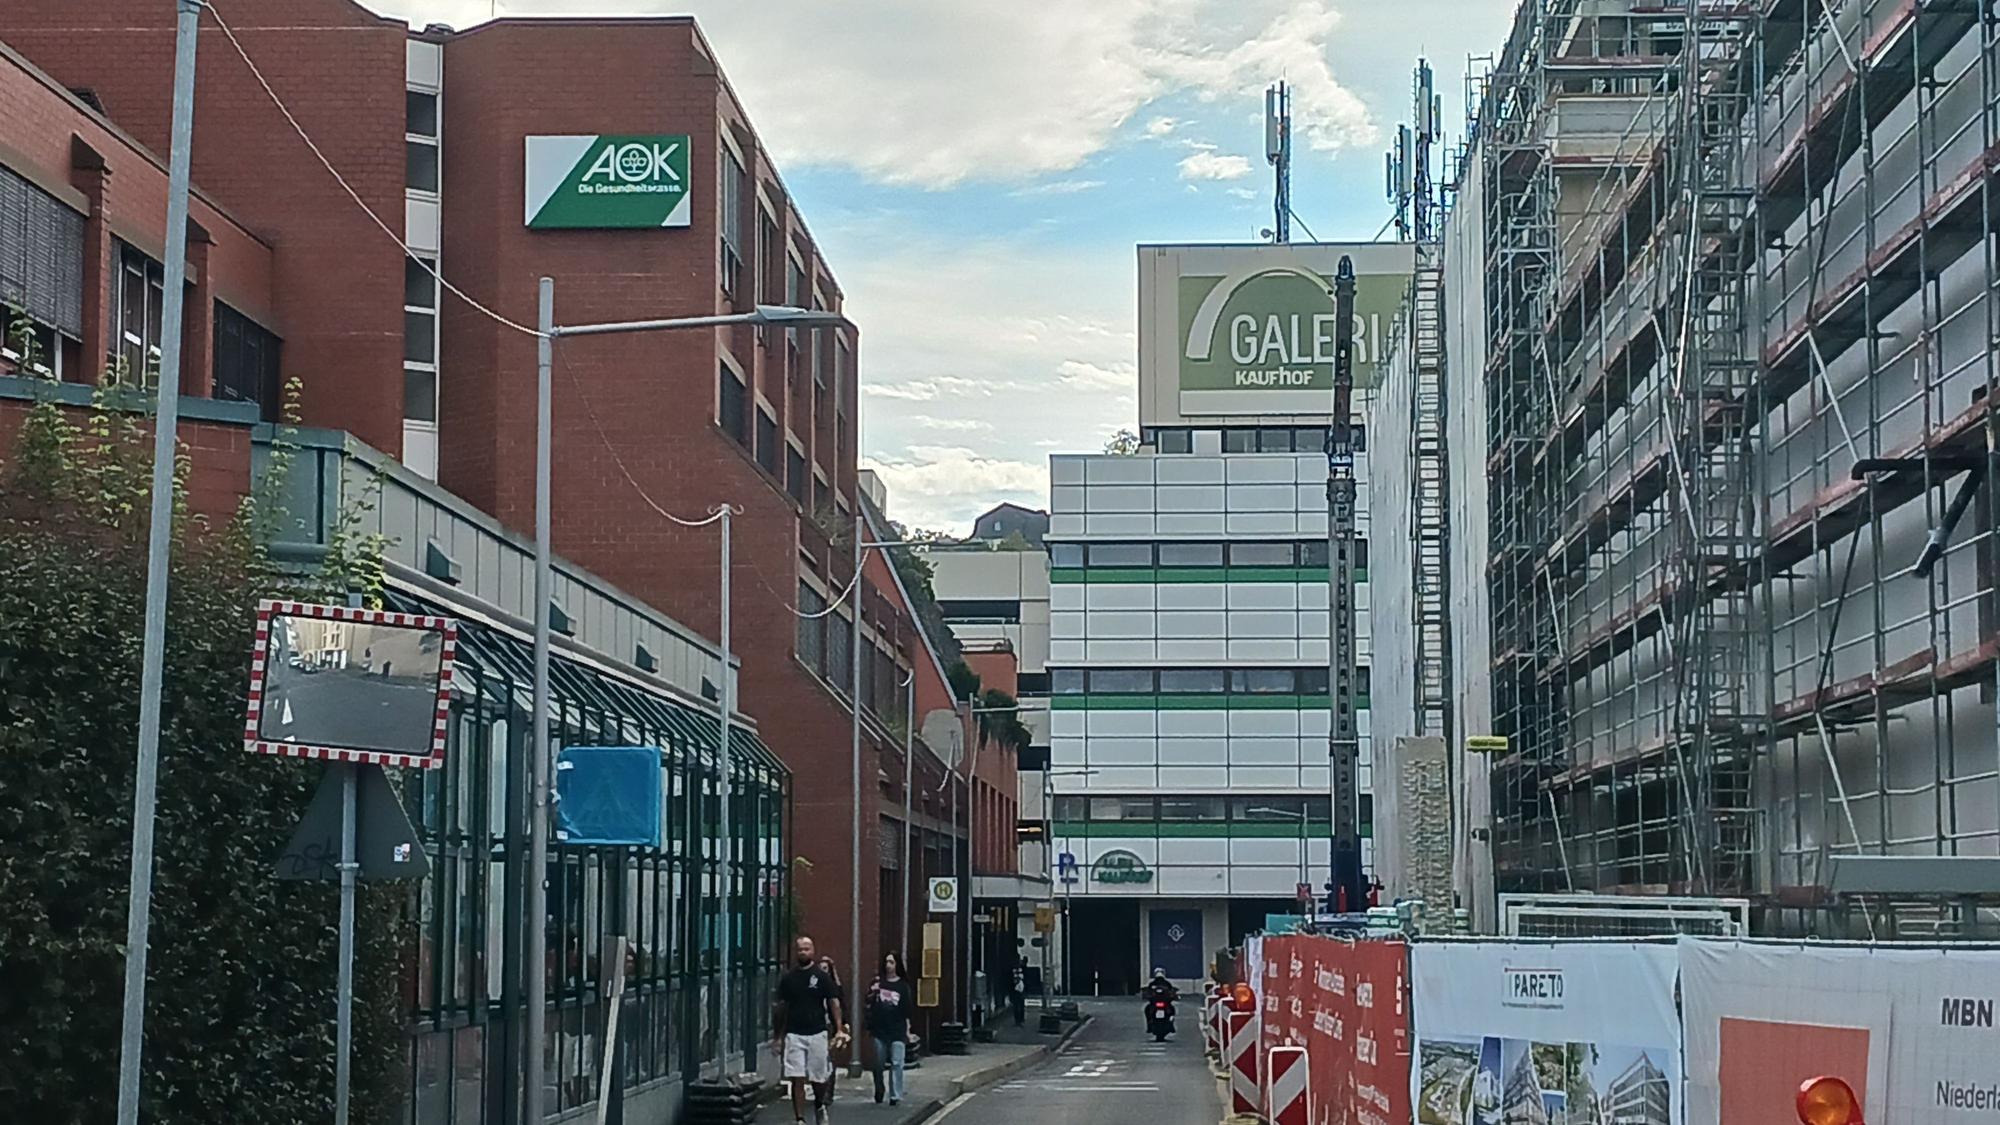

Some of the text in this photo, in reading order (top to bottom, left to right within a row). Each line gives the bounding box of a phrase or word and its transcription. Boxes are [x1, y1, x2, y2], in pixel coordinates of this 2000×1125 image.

[581, 143, 681, 182] AOK
[578, 183, 594, 193] Die
[1514, 973, 1564, 998] PARETO
[1941, 998, 1994, 1027] MBN
[1936, 1080, 2000, 1110] Niederl
